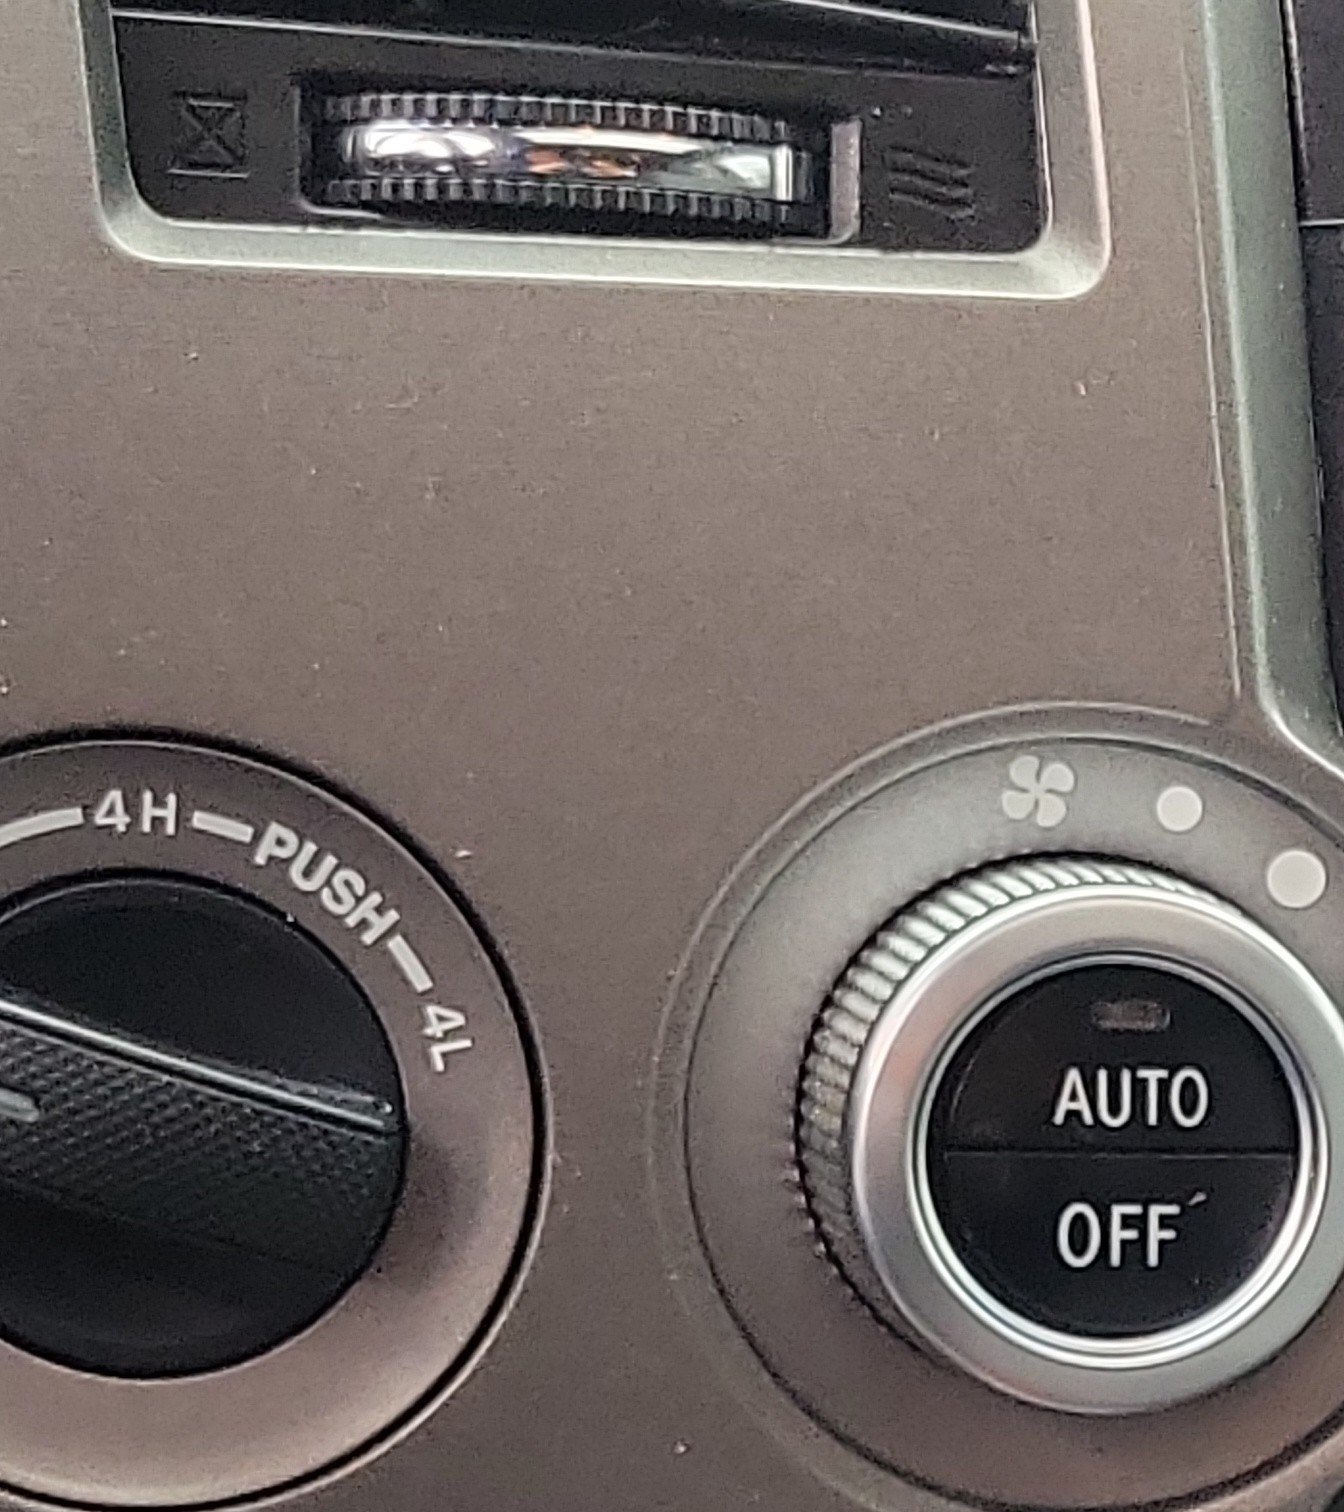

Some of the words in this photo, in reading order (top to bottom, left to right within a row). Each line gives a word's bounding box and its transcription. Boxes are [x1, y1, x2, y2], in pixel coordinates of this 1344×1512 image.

[252, 820, 400, 947] PUSH
[421, 1002, 475, 1073] 4L
[1051, 1066, 1210, 1129] AUTO
[1056, 1201, 1182, 1269] OFF
